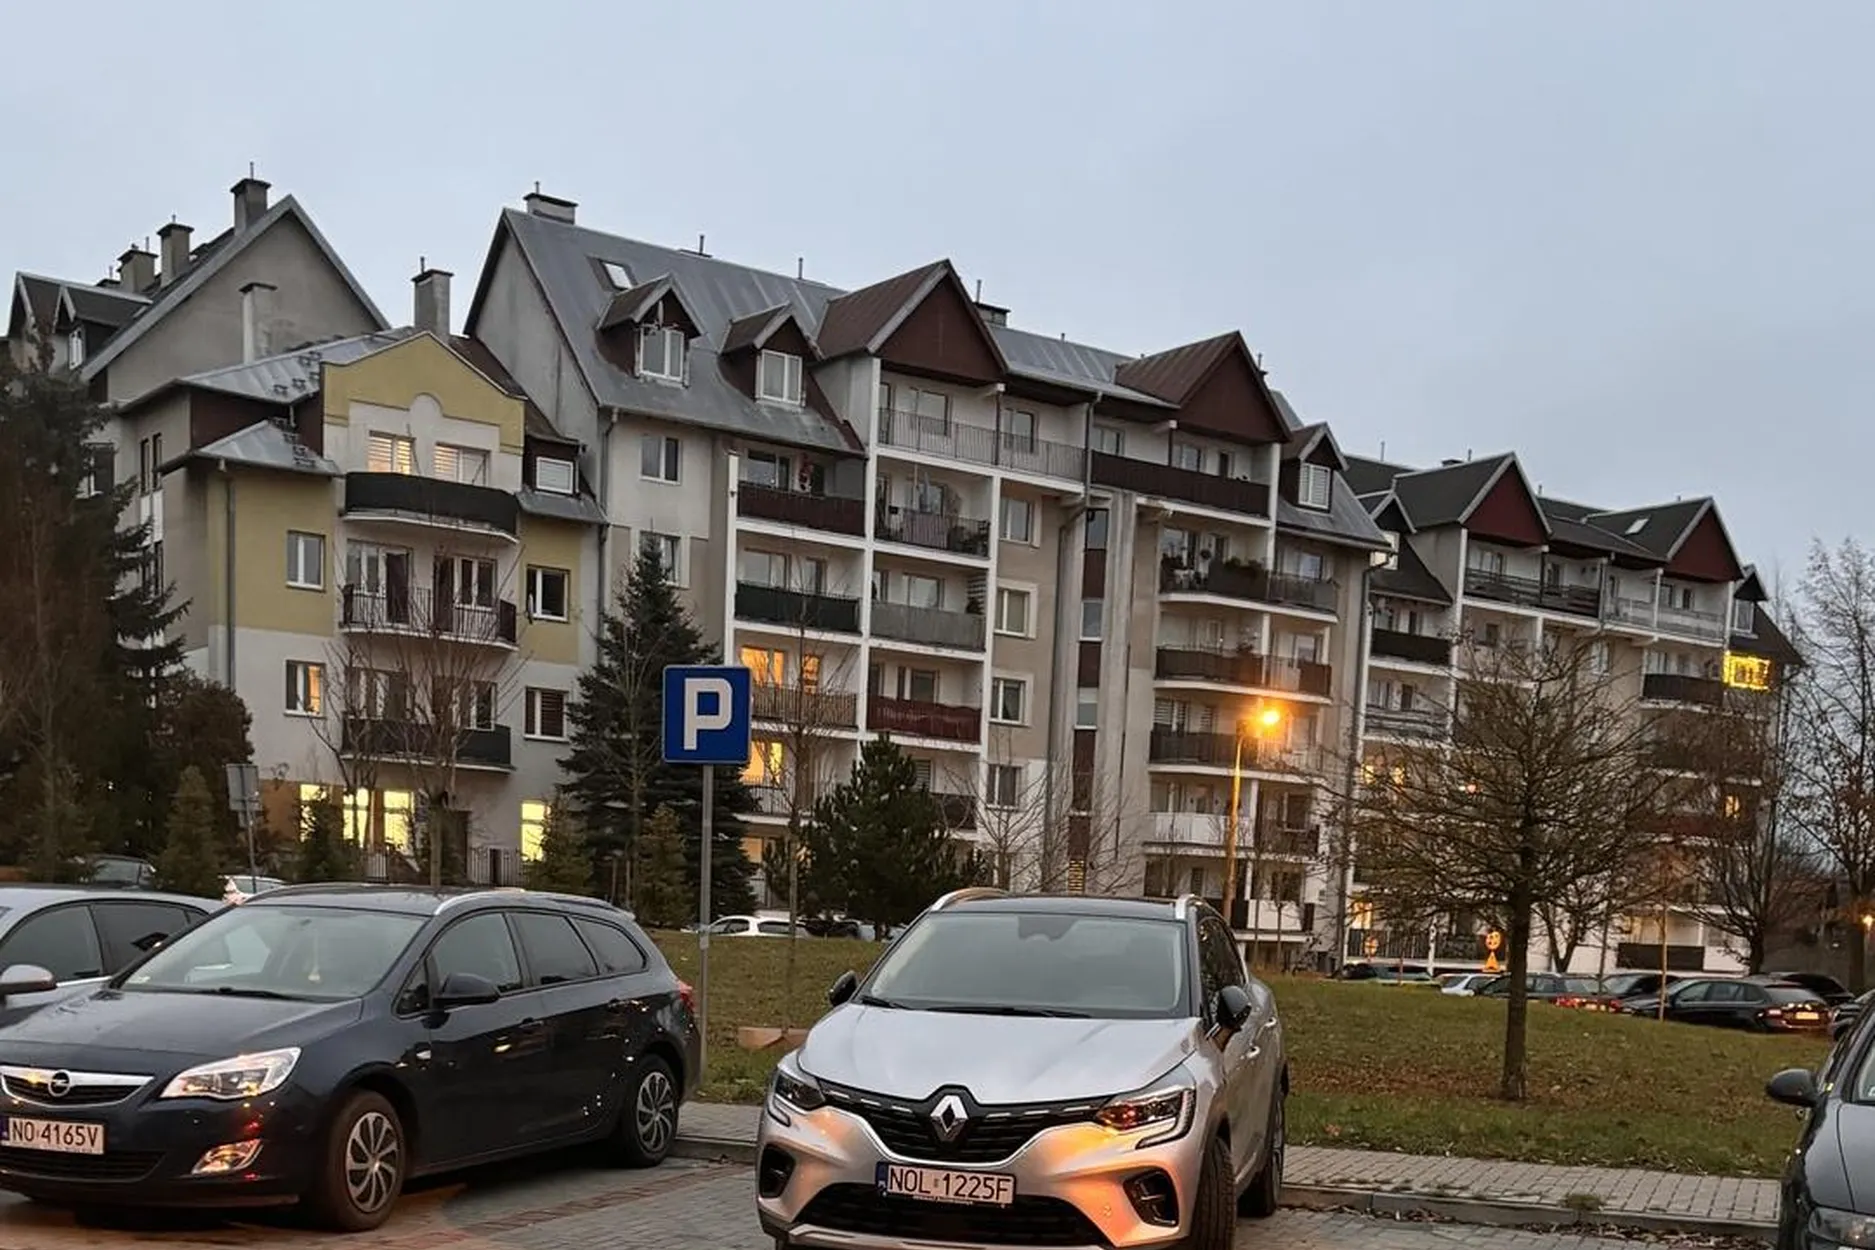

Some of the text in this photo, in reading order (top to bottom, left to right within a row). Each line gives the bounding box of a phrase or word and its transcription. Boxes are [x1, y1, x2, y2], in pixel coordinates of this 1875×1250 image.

[684, 678, 732, 750] P
[12, 1120, 98, 1148] NO 4165V
[889, 1168, 1011, 1200] NOL 1225F
